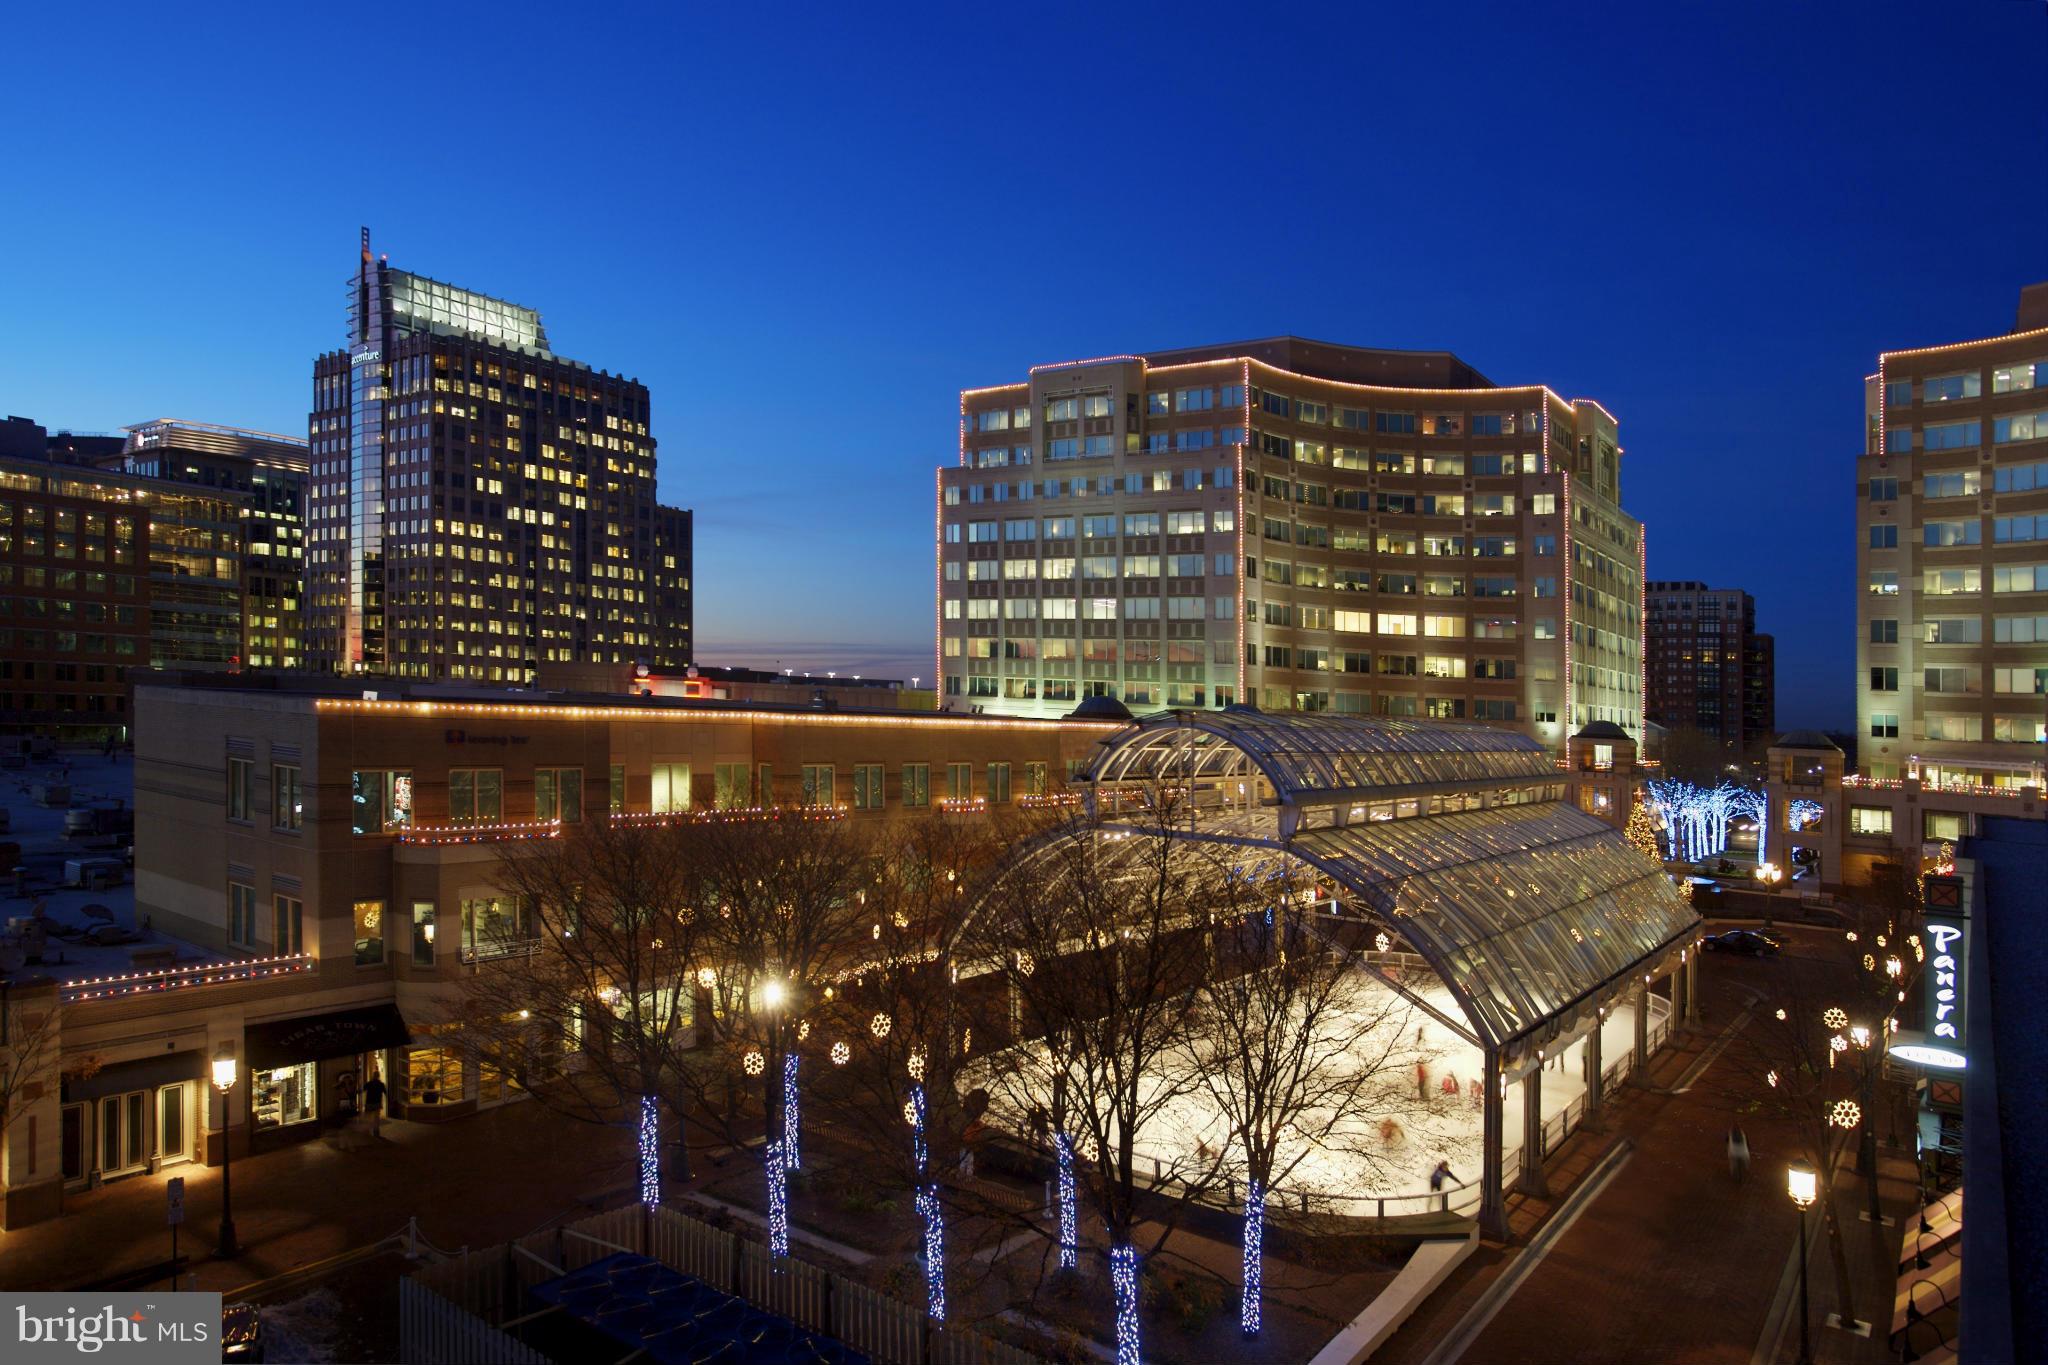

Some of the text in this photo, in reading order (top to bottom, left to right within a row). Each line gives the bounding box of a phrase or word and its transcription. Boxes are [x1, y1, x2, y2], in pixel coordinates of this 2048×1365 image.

[351, 350, 379, 365] accenture
[1927, 925, 1962, 1039] Panera
[279, 1024, 328, 1046] CIGAR
[335, 1022, 377, 1032] TOWN
